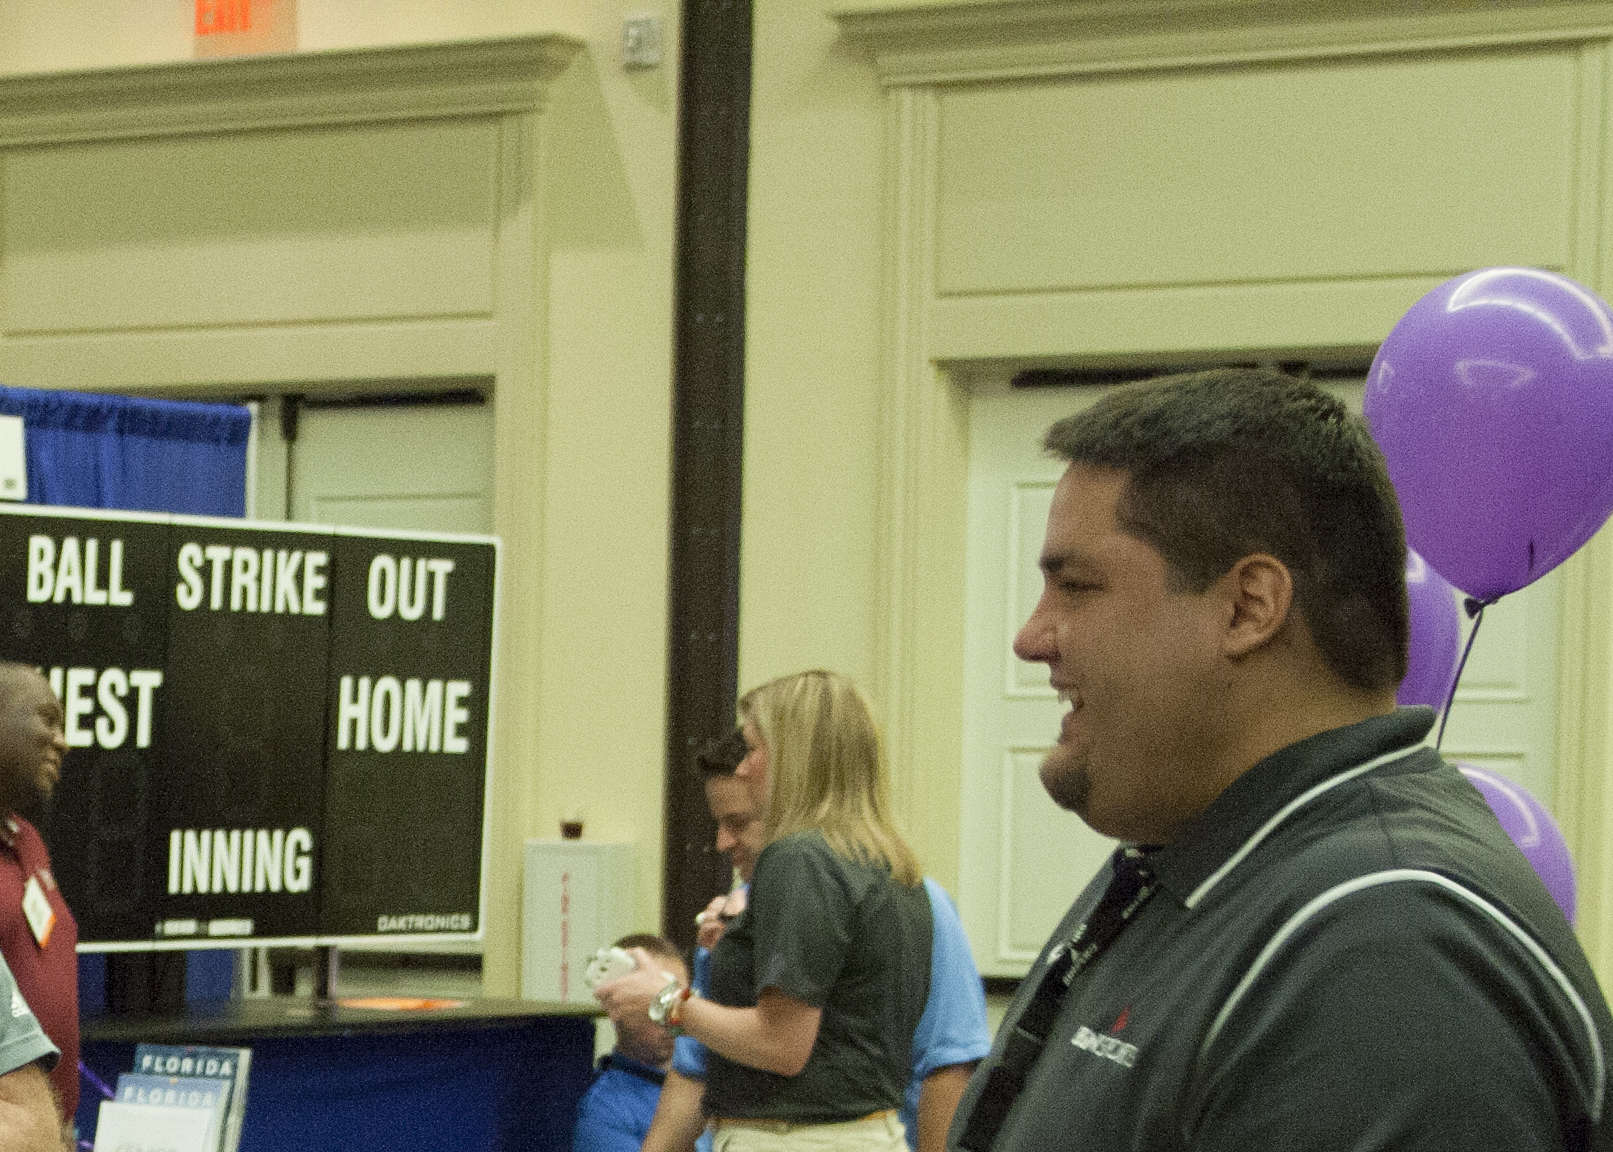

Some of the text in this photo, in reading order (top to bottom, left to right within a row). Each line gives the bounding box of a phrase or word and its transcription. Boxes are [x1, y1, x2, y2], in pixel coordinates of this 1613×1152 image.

[26, 535, 455, 621] BALL STRIKE OUT
[336, 675, 473, 755] HOME
[167, 827, 314, 895] INNING
[141, 1053, 234, 1077] FLORIDA
